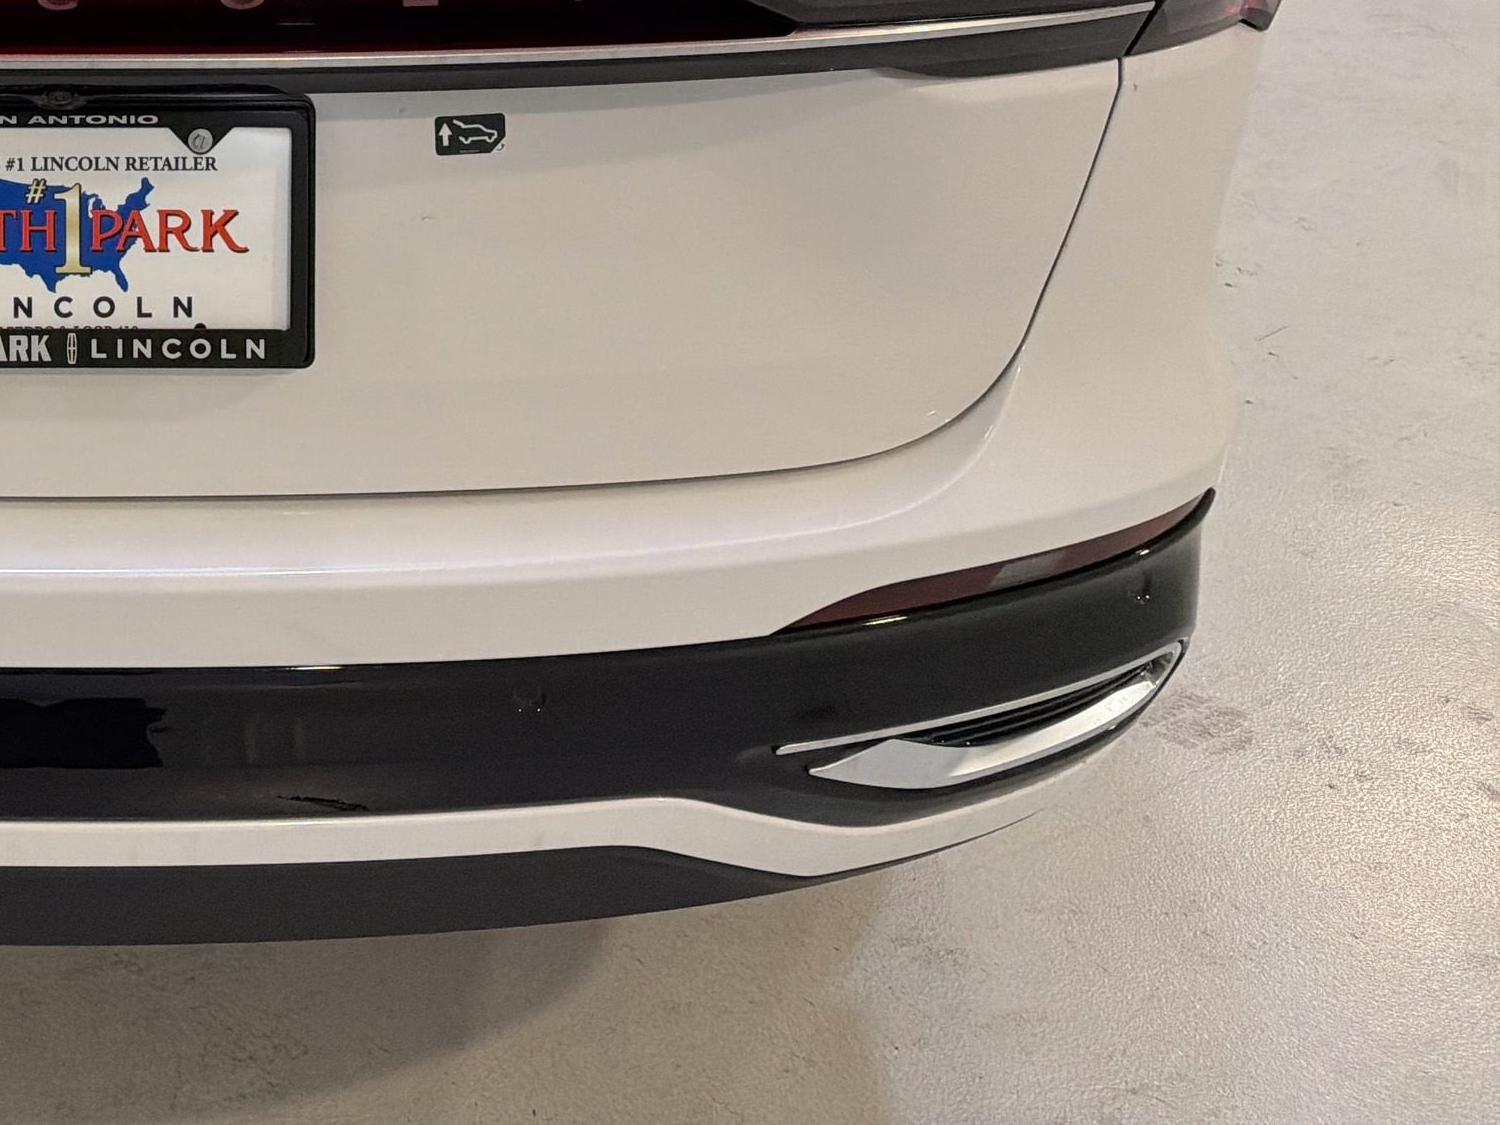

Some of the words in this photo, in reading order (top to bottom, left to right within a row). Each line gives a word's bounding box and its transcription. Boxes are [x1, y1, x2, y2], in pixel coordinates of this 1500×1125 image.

[27, 114, 159, 125] ANTONIO
[5, 157, 25, 171] #1
[31, 157, 119, 171] LINCOLN
[125, 156, 218, 171] RETAILER
[90, 209, 250, 254] PARK
[90, 338, 266, 360] LINCOLN
